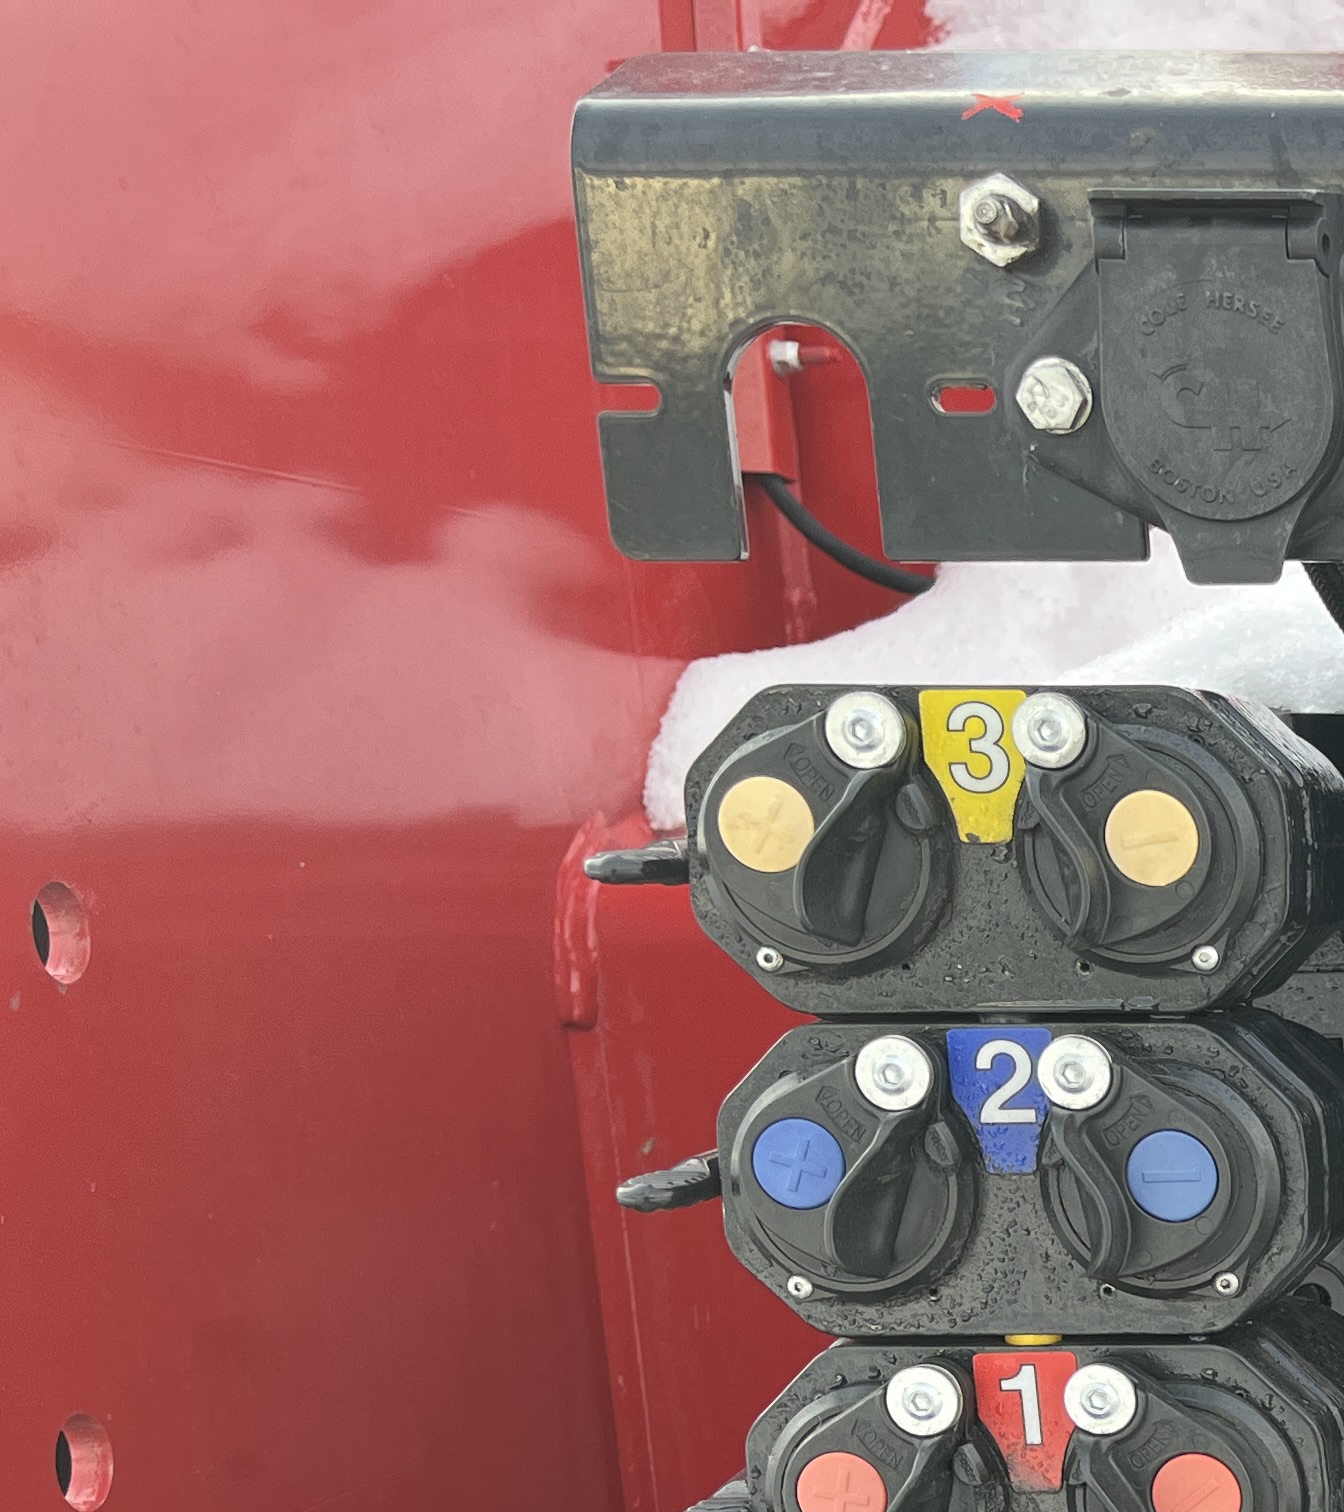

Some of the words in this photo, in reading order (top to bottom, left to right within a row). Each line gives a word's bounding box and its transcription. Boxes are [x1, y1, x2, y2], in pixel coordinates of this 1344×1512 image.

[1139, 293, 1189, 336] COLE
[1204, 291, 1284, 334] HERSEE
[1151, 458, 1235, 504] BOSTON
[947, 701, 1010, 793] 3
[795, 757, 835, 802] OPEN
[1081, 764, 1125, 809] OPEN
[974, 1040, 1037, 1124] 2
[825, 1099, 867, 1142] OPEN
[1104, 1102, 1147, 1147] OPEN
[1000, 1364, 1043, 1446] 1
[864, 1429, 904, 1469] OPEN
